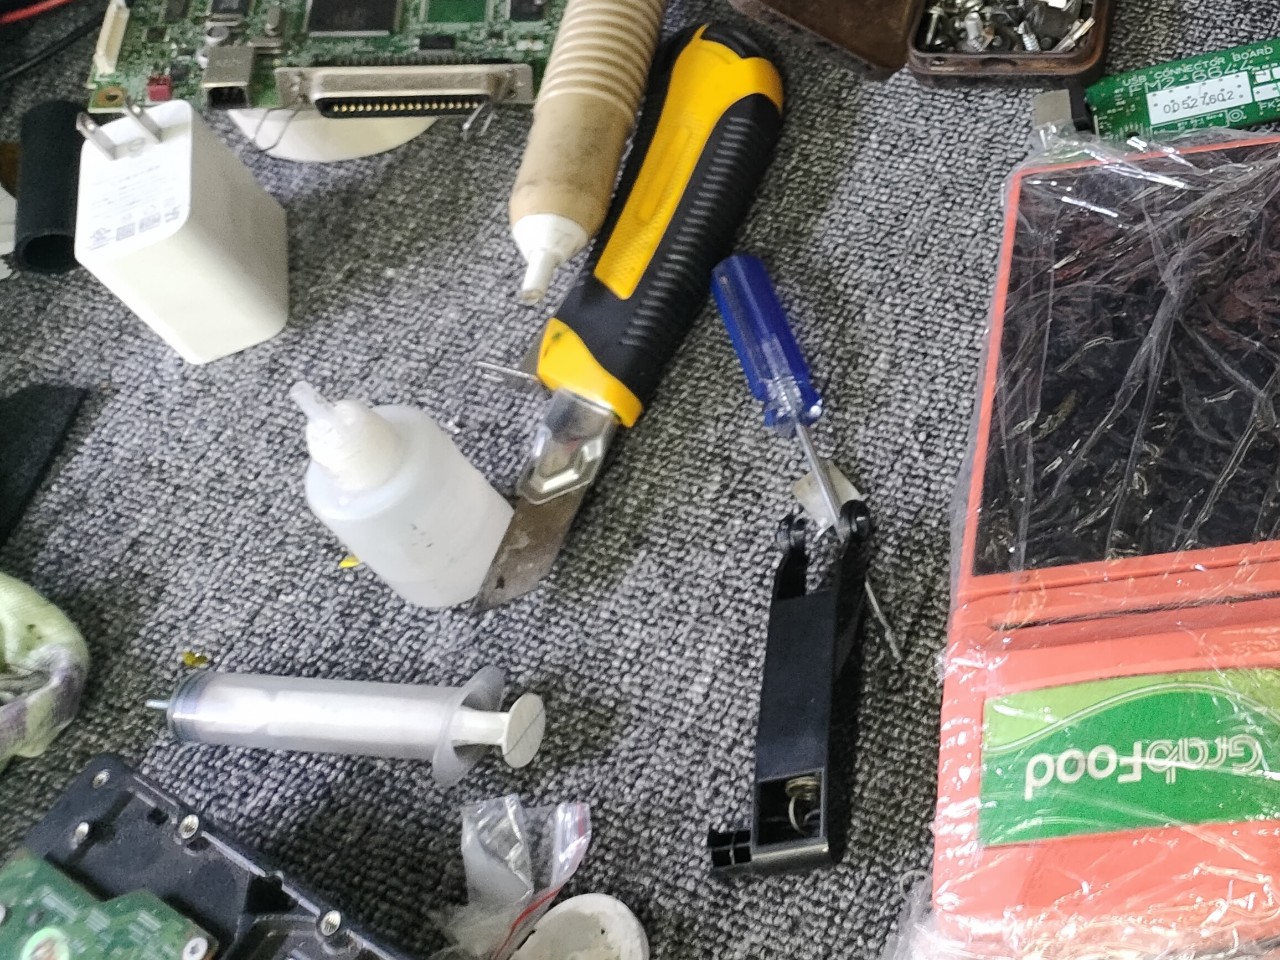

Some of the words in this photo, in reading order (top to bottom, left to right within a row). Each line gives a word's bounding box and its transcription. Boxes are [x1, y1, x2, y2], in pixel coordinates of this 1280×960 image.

[1121, 74, 1147, 87] USB
[1153, 56, 1226, 80] CONNECTOR
[1231, 46, 1274, 62] BOARD
[1128, 60, 1253, 97] FM2-6644
[1024, 733, 1264, 801] GrabFood
